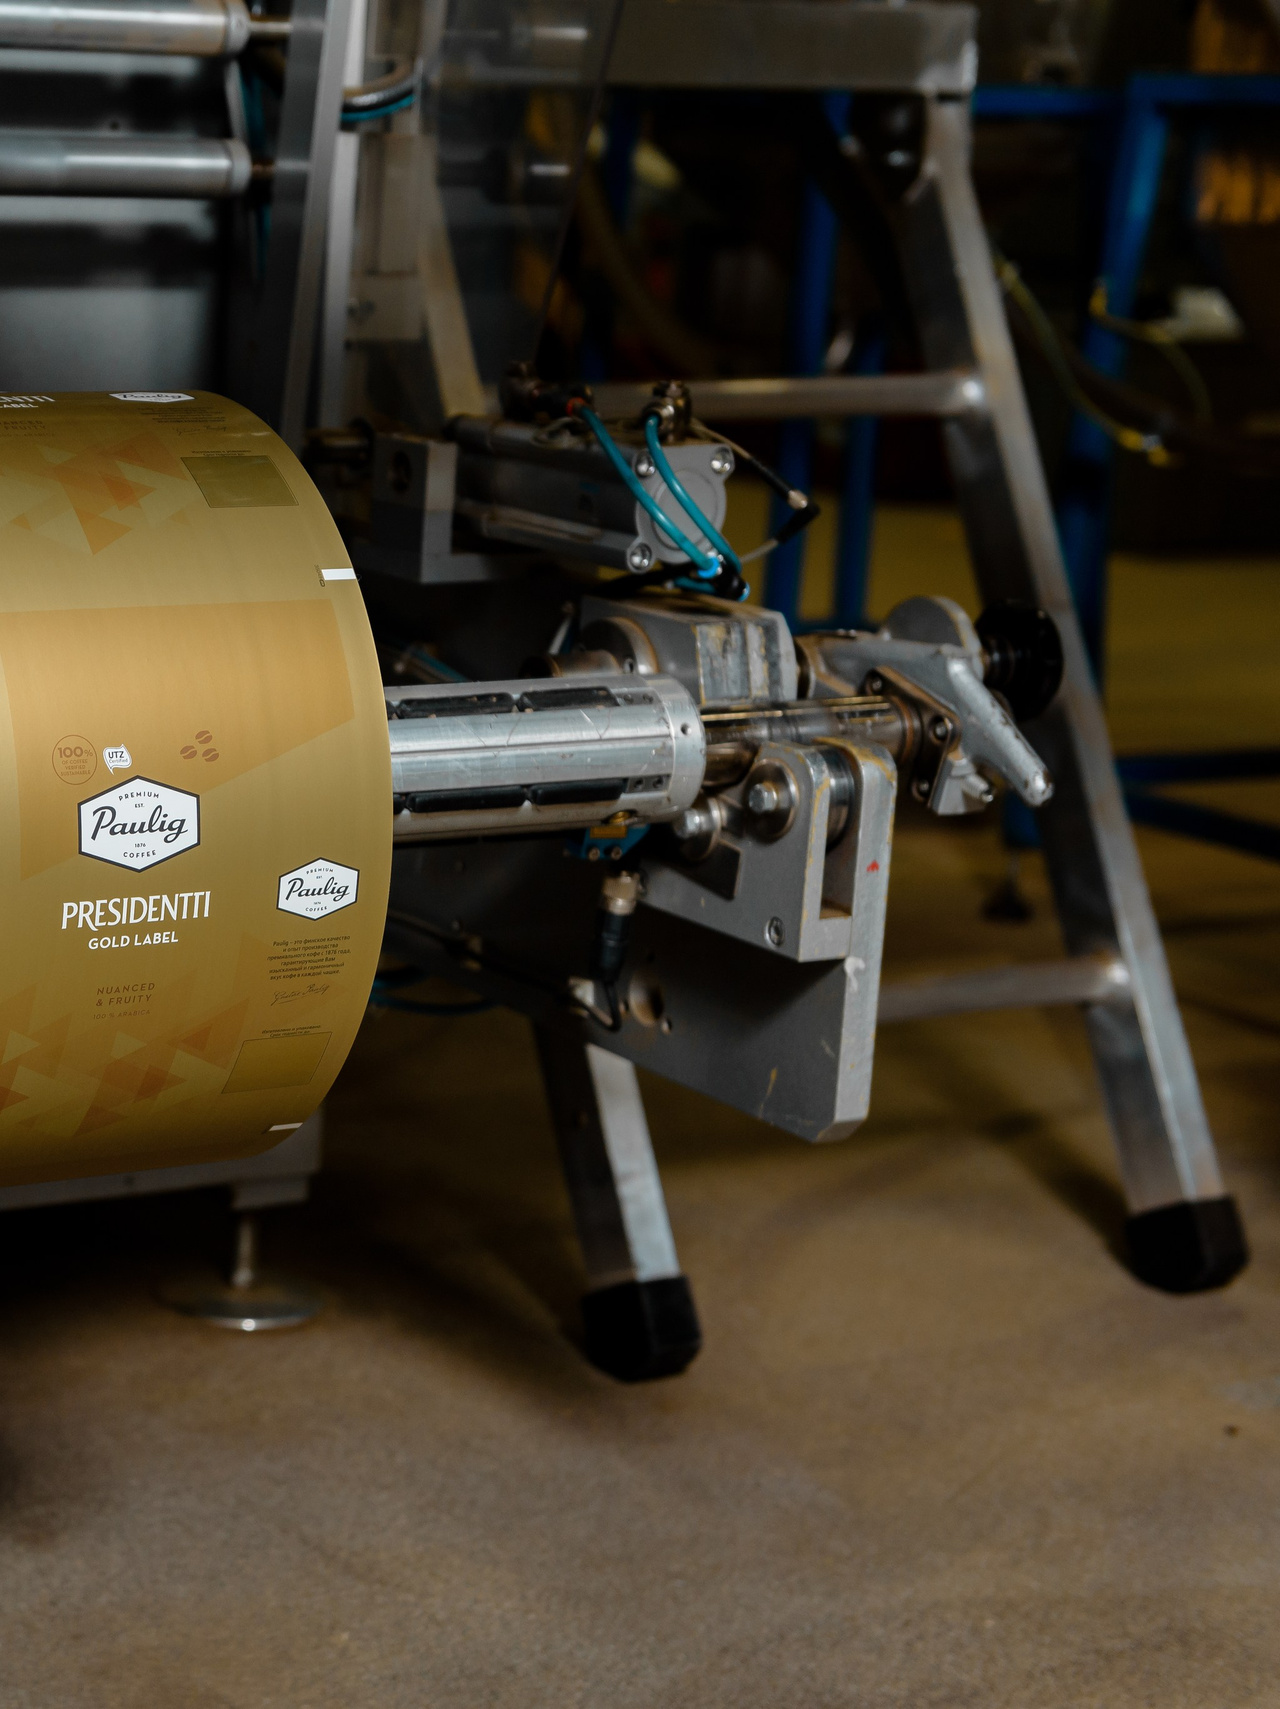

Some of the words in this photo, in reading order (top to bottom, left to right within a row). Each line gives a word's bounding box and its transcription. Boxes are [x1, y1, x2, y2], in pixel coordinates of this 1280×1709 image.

[57, 746, 94, 760] 100%
[108, 750, 125, 760] UTZ
[118, 791, 160, 802] PREMIUM
[91, 804, 188, 844] Paulig
[123, 850, 158, 859] COFFEE
[306, 867, 334, 875] PREMIUM
[286, 876, 350, 902] Paulig
[61, 890, 212, 932] PRESIDENTTI
[88, 934, 130, 950] GOLD
[134, 930, 180, 946] LABEL
[307, 950, 320, 958] кофе
[96, 982, 156, 996] NUANCED
[96, 998, 104, 1007] &
[108, 994, 152, 1006] FRUITY
[117, 1010, 150, 1018] ARABICA
